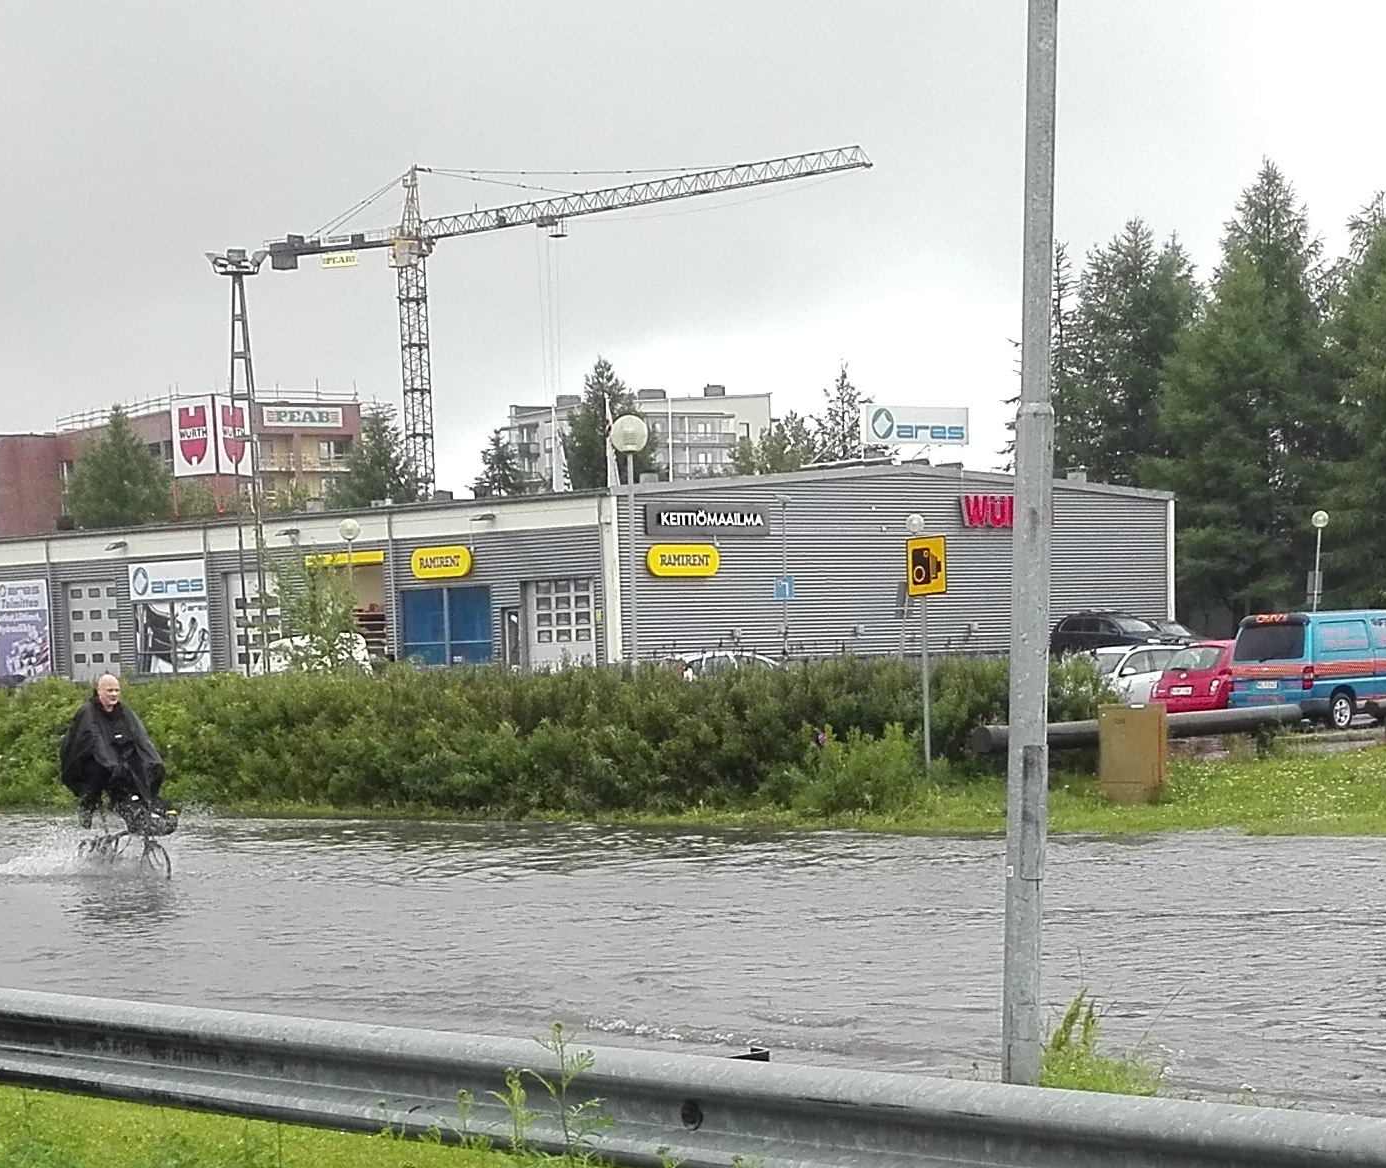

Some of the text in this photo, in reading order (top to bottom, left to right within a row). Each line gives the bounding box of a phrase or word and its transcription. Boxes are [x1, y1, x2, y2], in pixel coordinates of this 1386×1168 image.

[275, 410, 330, 423] PEAB
[897, 425, 964, 439] ares
[660, 510, 764, 526] KEITTIÖMAAILMA
[419, 555, 461, 569] RAMIRENT
[660, 554, 711, 566] RAMIRENT
[151, 579, 204, 594] ares
